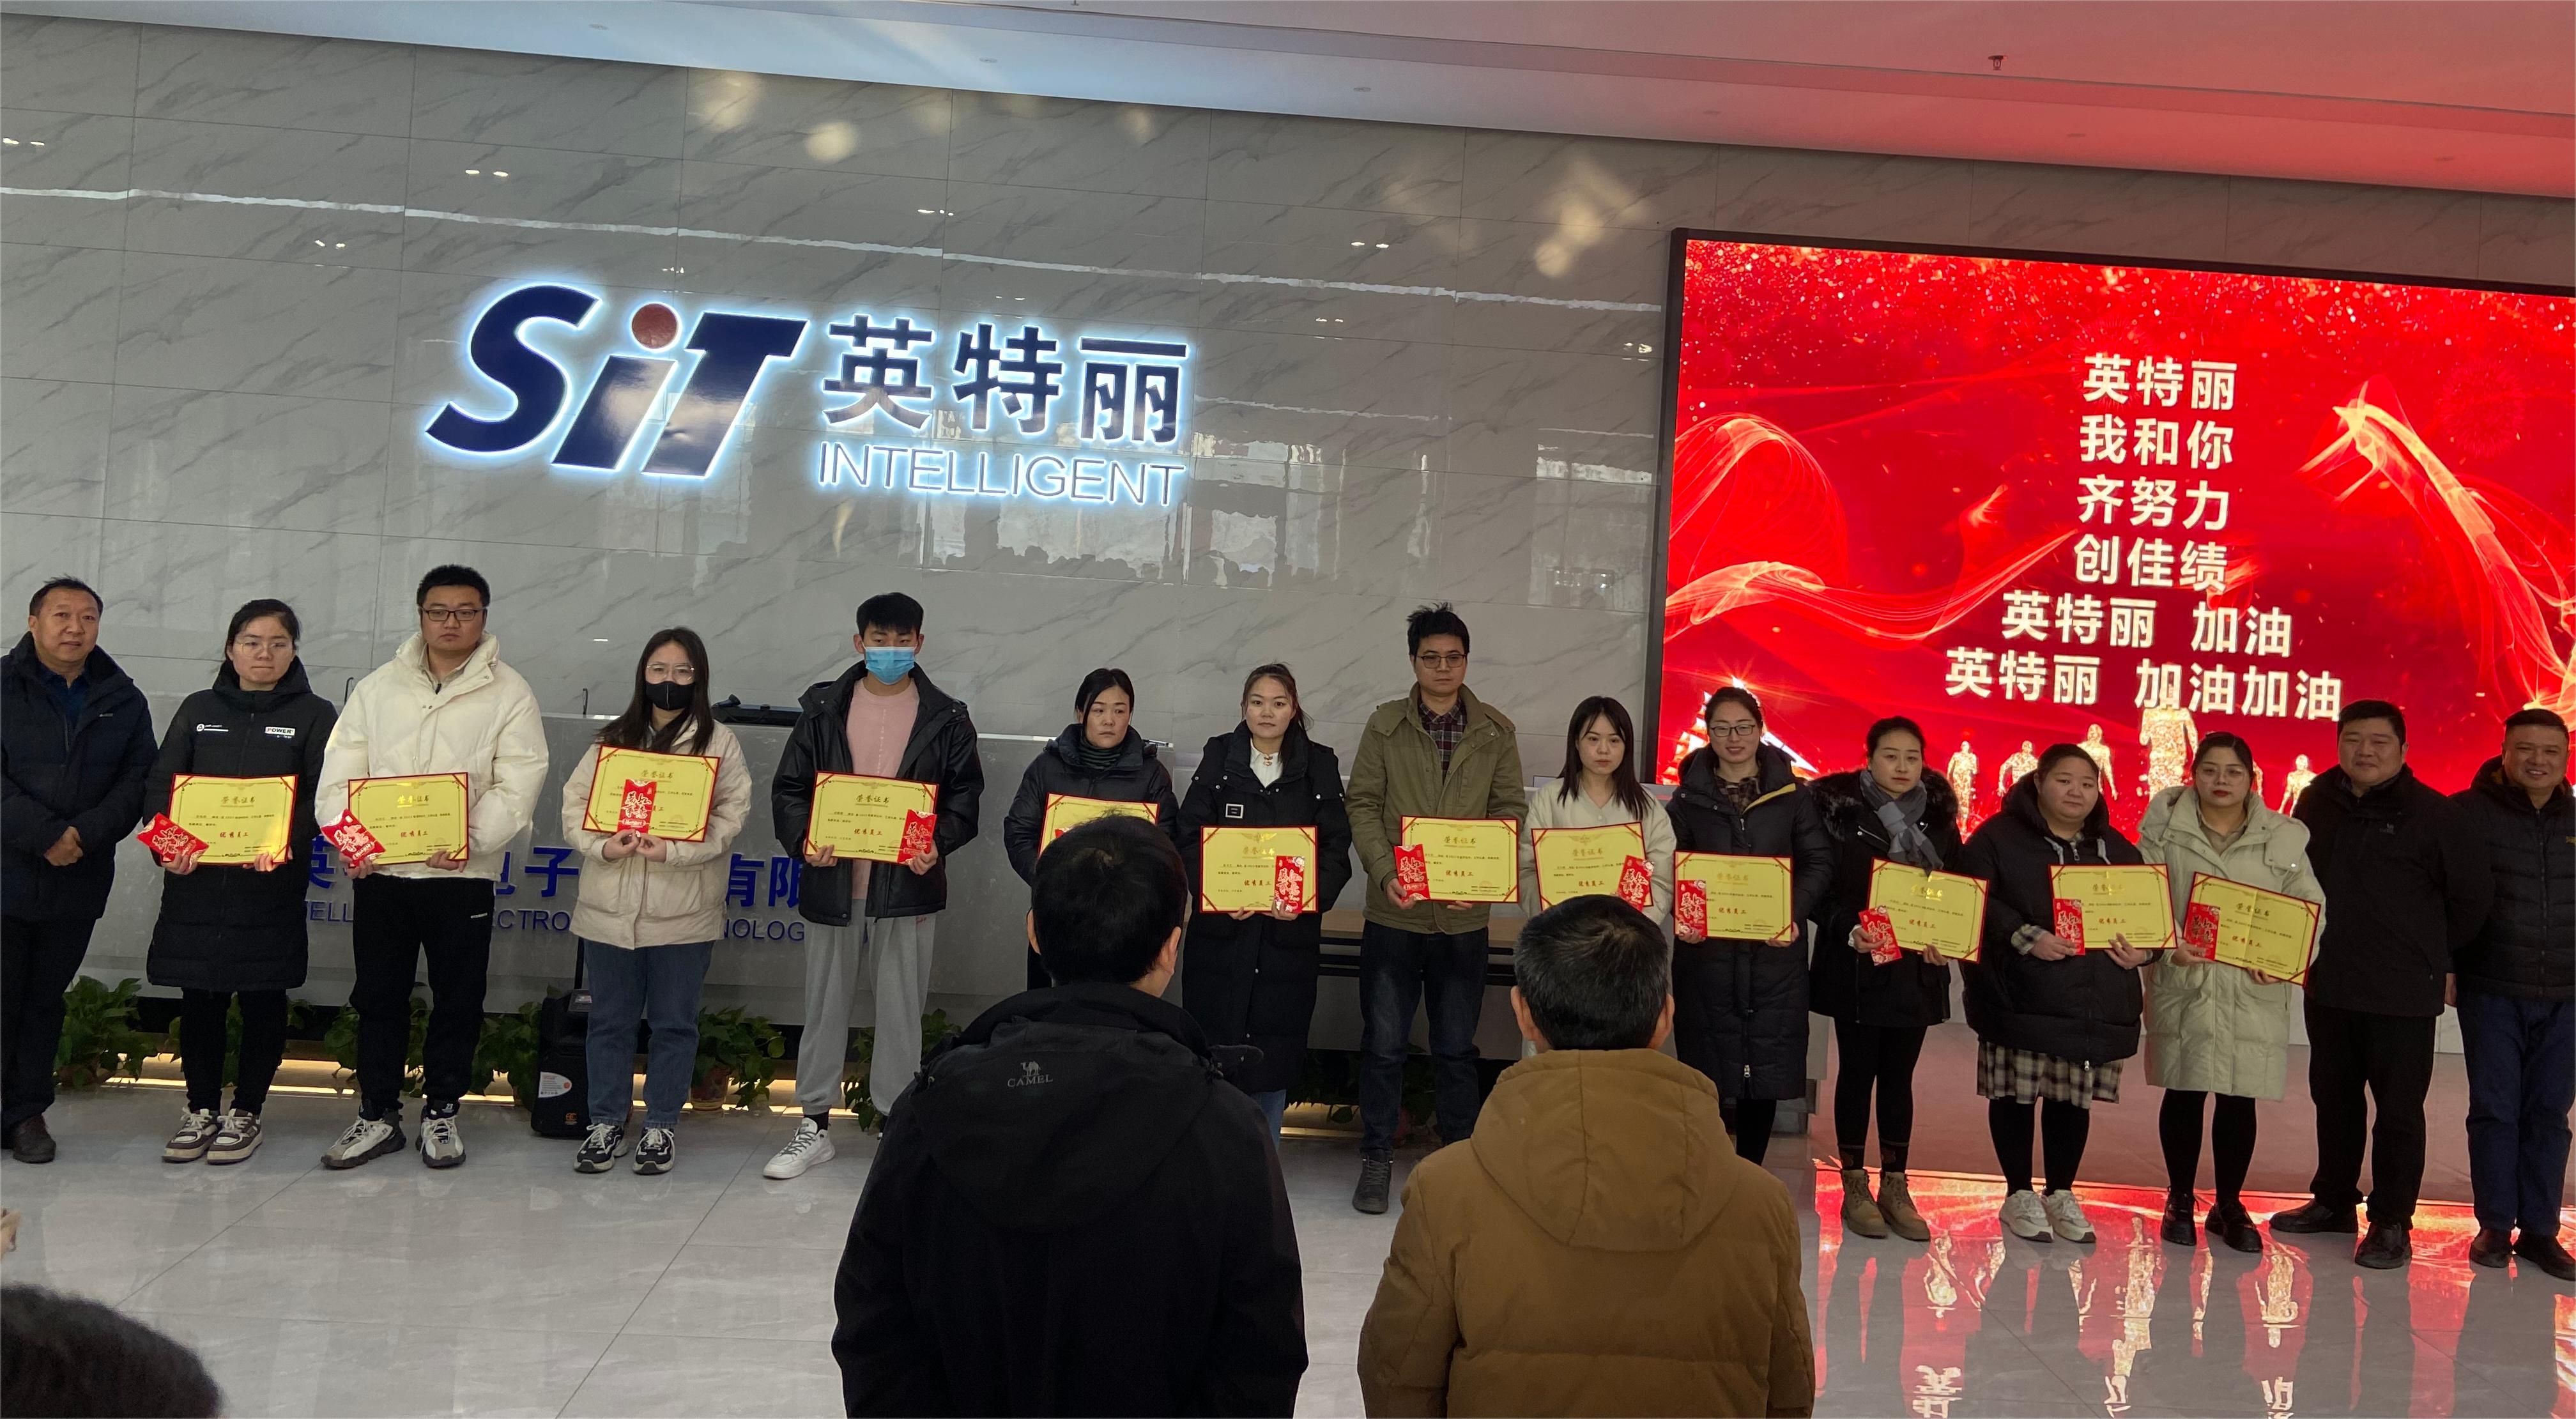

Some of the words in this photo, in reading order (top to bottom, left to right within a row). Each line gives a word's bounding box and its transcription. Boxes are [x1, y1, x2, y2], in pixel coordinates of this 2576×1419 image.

[823, 314, 1188, 443] 英特丽
[2083, 353, 2237, 411] 英特丽
[2080, 414, 2234, 470] 我和你
[819, 441, 1184, 505] INTELLIGENT
[2078, 473, 2230, 530] 齐努力
[2074, 533, 2228, 592] 创佳绩
[2002, 590, 2158, 648] 英特丽
[2191, 601, 2292, 658] 加油
[1945, 647, 2101, 705] 英特丽
[2135, 658, 2341, 721] 加油加油
[493, 908, 571, 931] CTRO
[1008, 1075, 1053, 1087] CAMEL
